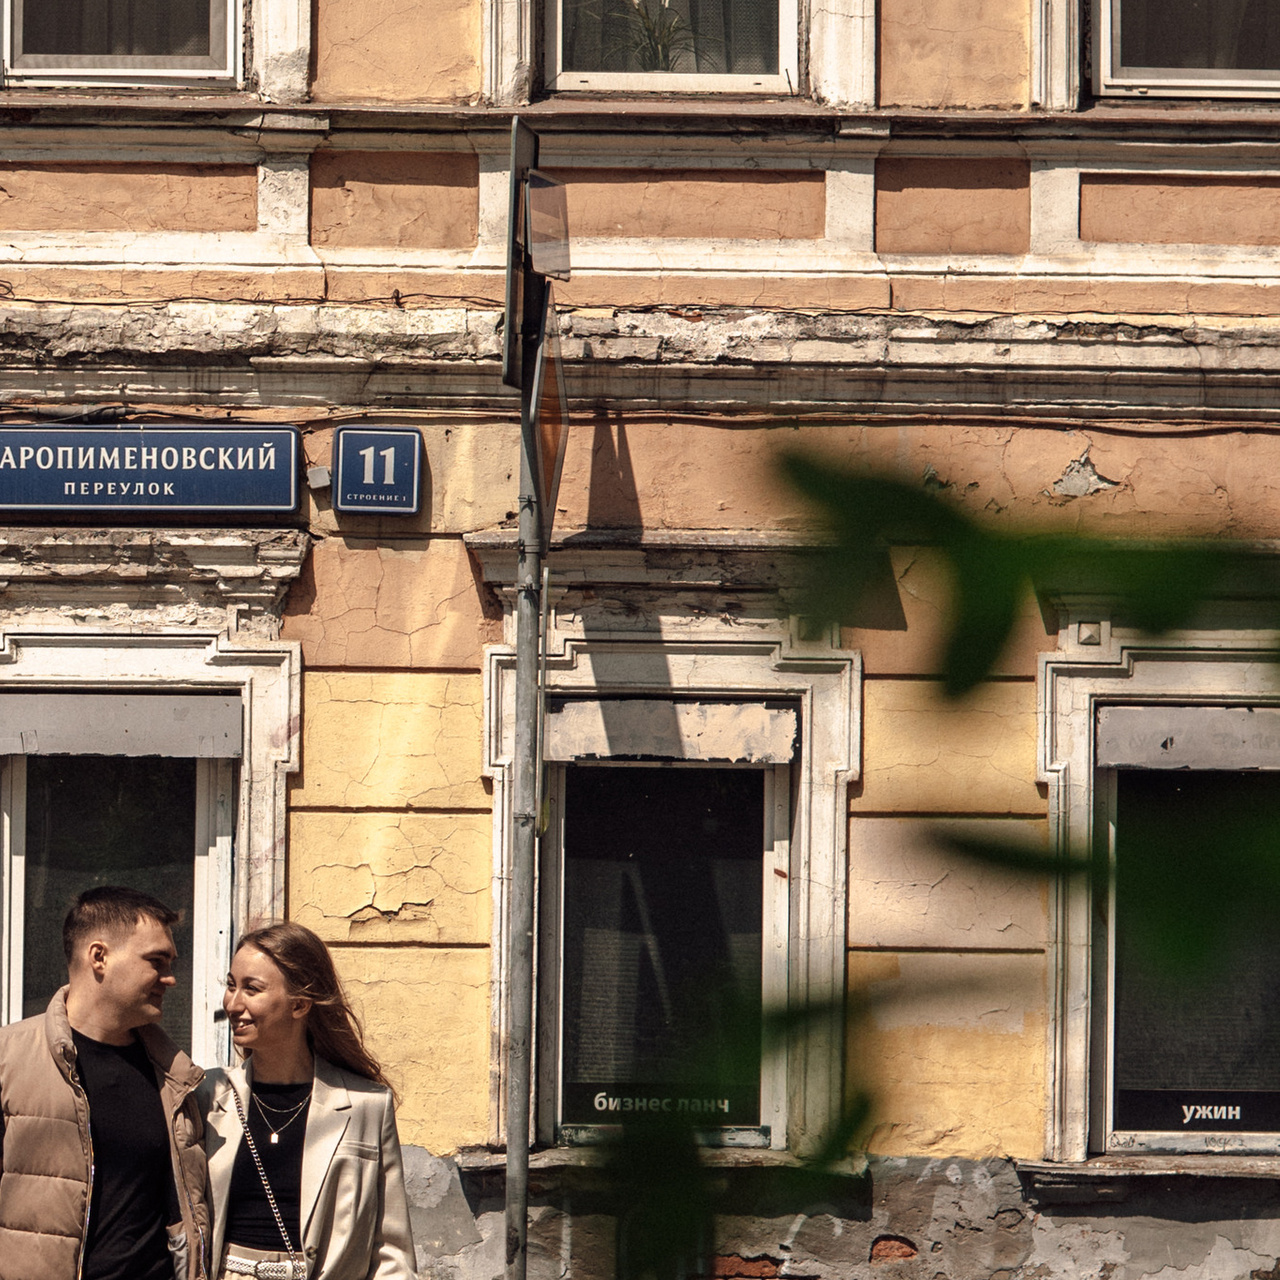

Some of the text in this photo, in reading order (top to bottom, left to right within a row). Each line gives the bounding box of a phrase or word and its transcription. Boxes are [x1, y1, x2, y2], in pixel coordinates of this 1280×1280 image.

[359, 445, 396, 485] 11
[64, 481, 175, 496] ПЕРЕУЛОК
[346, 493, 399, 501] СТРОЕНИЕ
[593, 1092, 730, 1113] бизнес ланч
[1181, 1105, 1241, 1124] ужин
